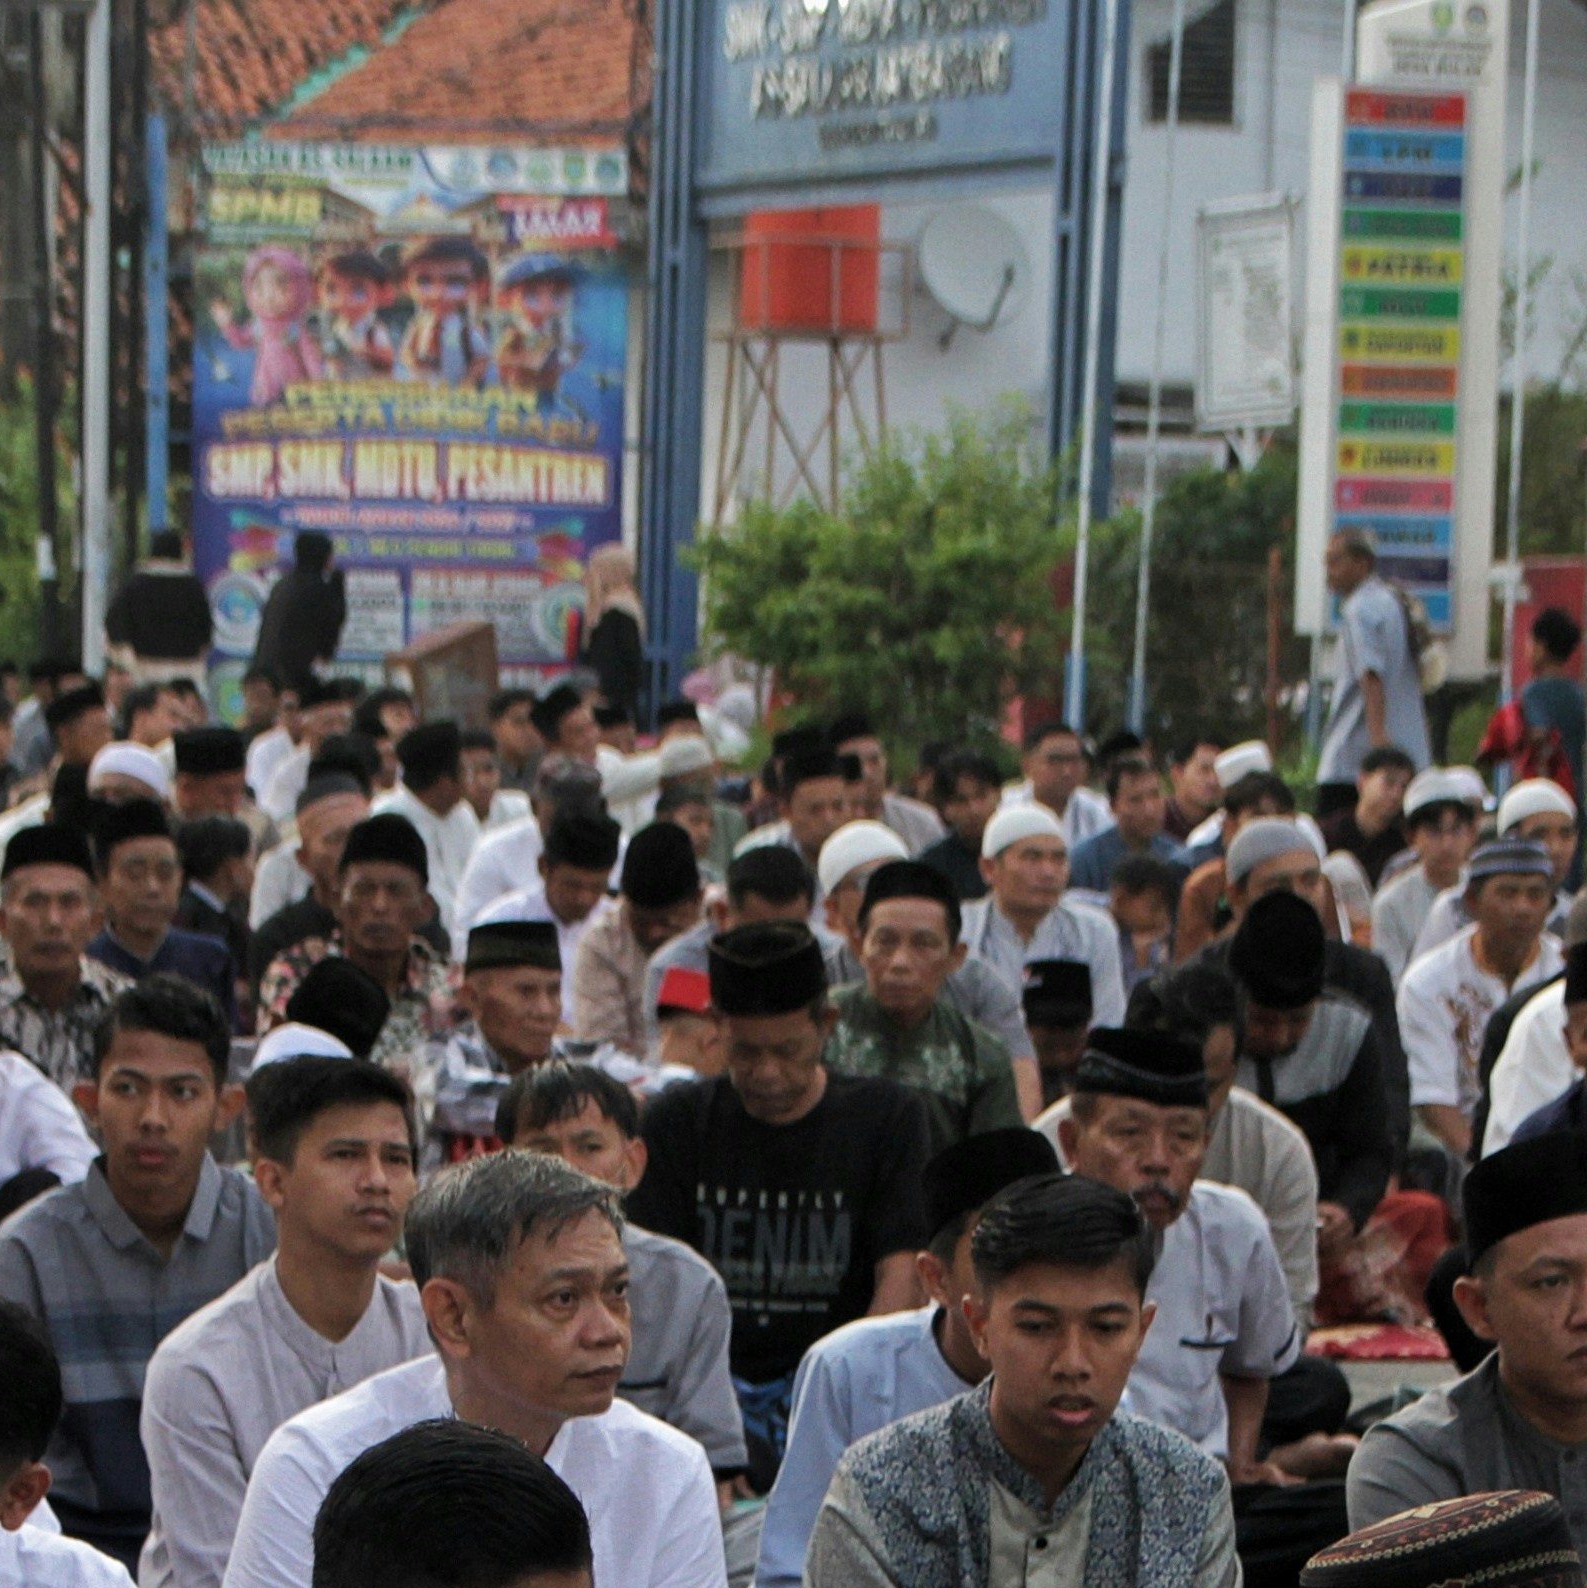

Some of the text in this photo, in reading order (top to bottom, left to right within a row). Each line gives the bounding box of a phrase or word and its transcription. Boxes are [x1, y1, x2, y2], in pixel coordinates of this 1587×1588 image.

[210, 188, 322, 226] SPMB
[447, 441, 607, 505] PESANTREN
[696, 1183, 844, 1208] SUPERFLY
[696, 1208, 852, 1278] DENIM
